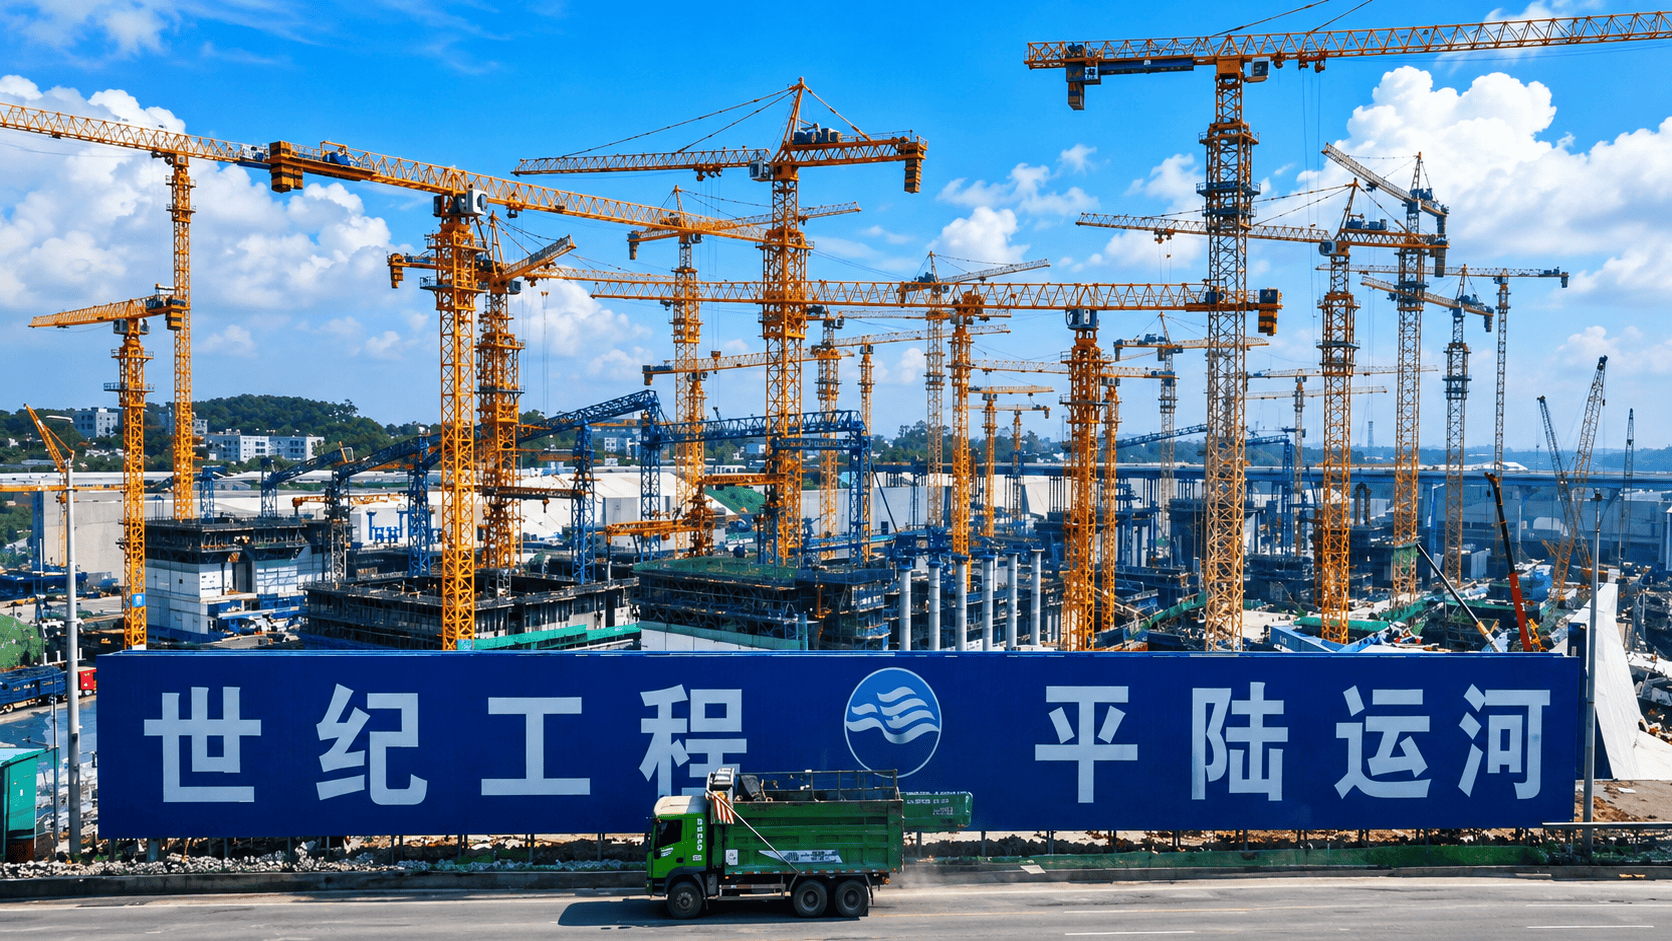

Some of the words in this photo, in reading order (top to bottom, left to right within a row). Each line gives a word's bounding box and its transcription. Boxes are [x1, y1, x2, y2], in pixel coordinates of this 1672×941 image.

[144, 684, 747, 805] 世纪工程
[1035, 682, 1550, 803] 平陆运河
